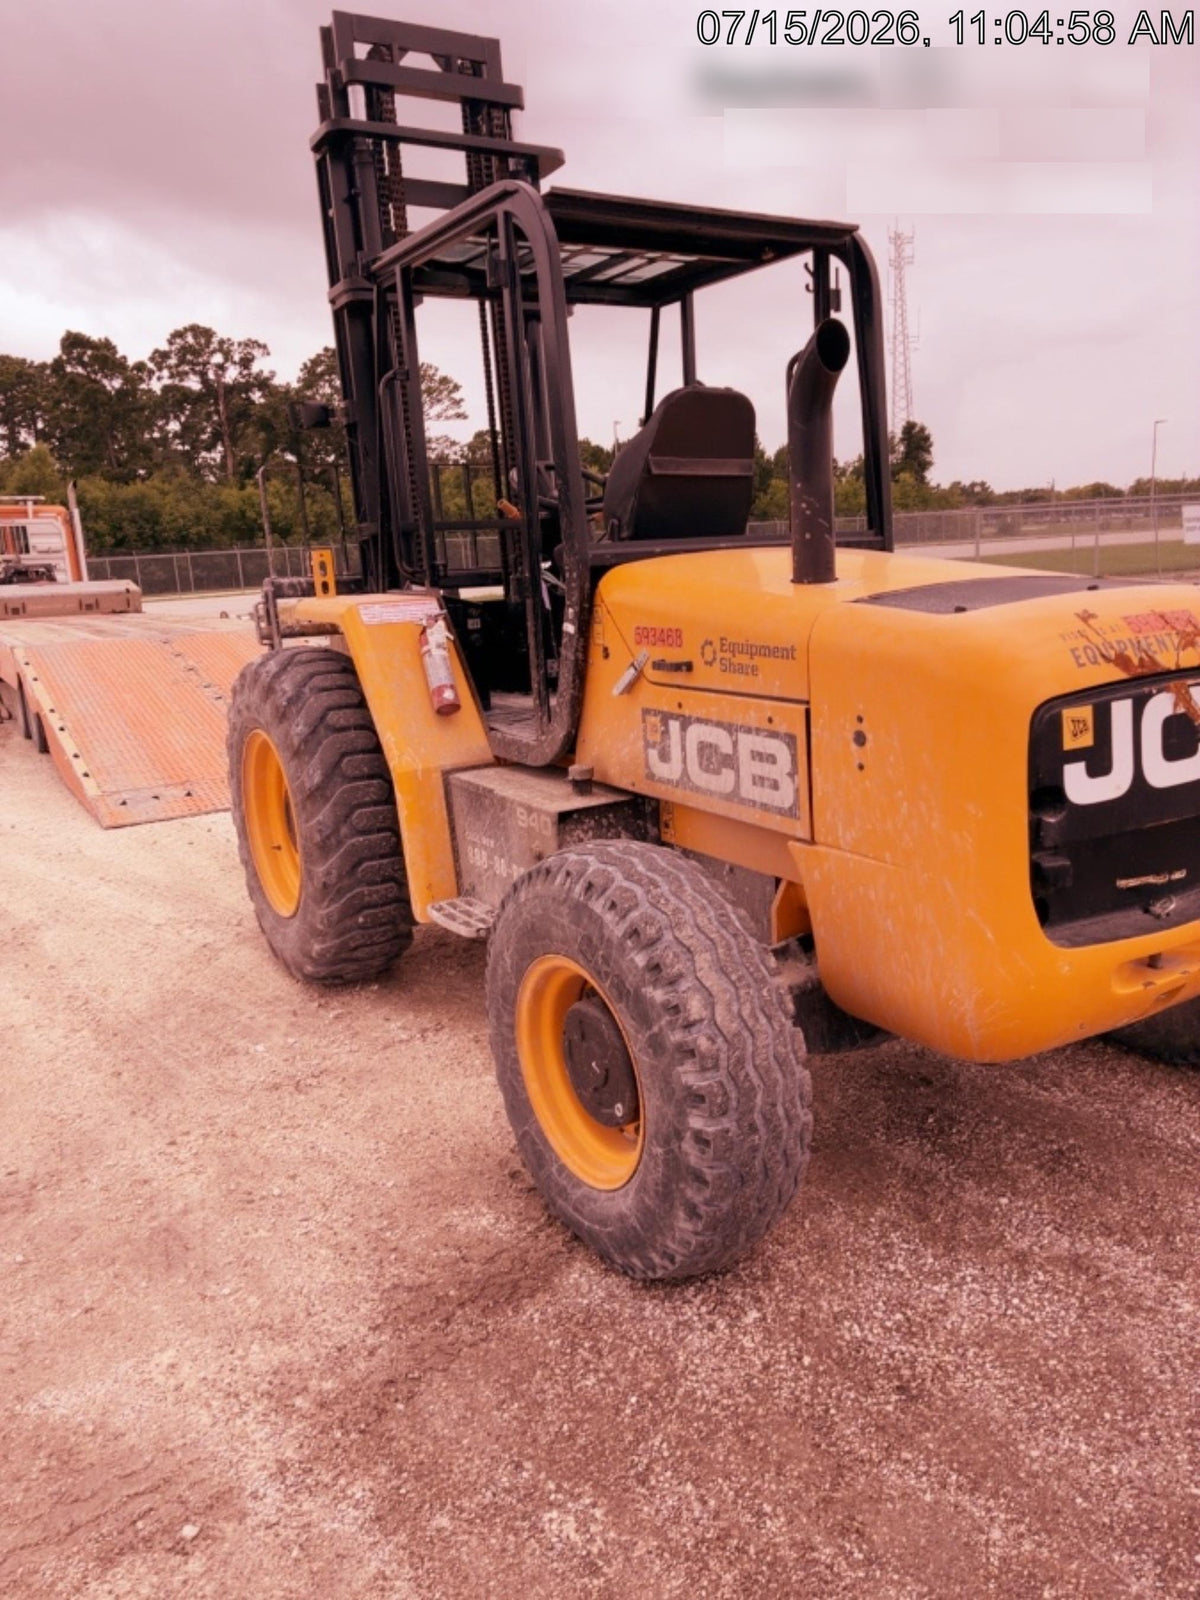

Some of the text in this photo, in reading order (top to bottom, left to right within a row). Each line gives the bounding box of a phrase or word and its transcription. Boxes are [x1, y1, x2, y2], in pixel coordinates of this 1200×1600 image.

[719, 637, 797, 660] Equipment
[719, 657, 759, 676] Share
[647, 719, 795, 809] JCB
